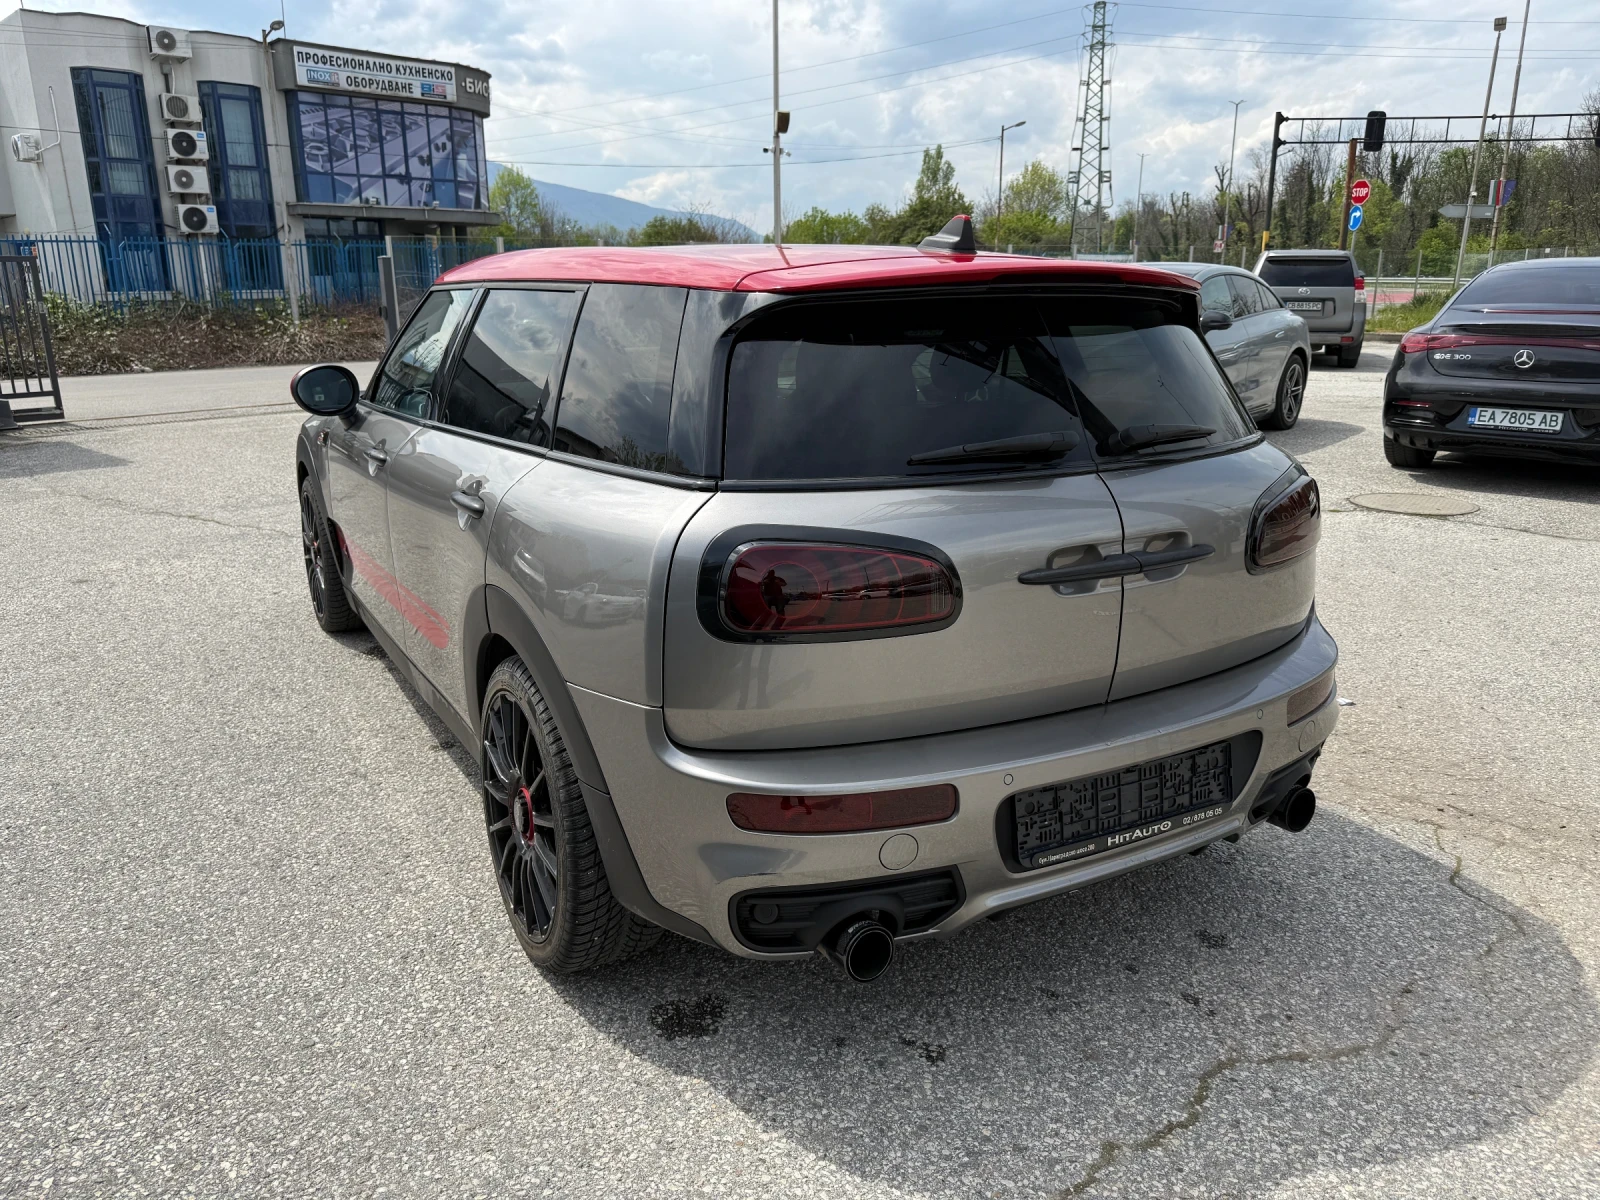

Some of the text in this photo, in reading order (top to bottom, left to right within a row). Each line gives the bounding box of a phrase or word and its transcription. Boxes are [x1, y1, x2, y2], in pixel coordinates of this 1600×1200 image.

[297, 51, 453, 81] ПРОФЕСИОНАЛНО КУХНЕНСКО
[346, 75, 414, 94] ОБОРУДВАНЕ
[1352, 187, 1369, 197] STOP
[1477, 409, 1559, 428] EA 7805 AB
[1183, 807, 1222, 825] 02/878 05 05
